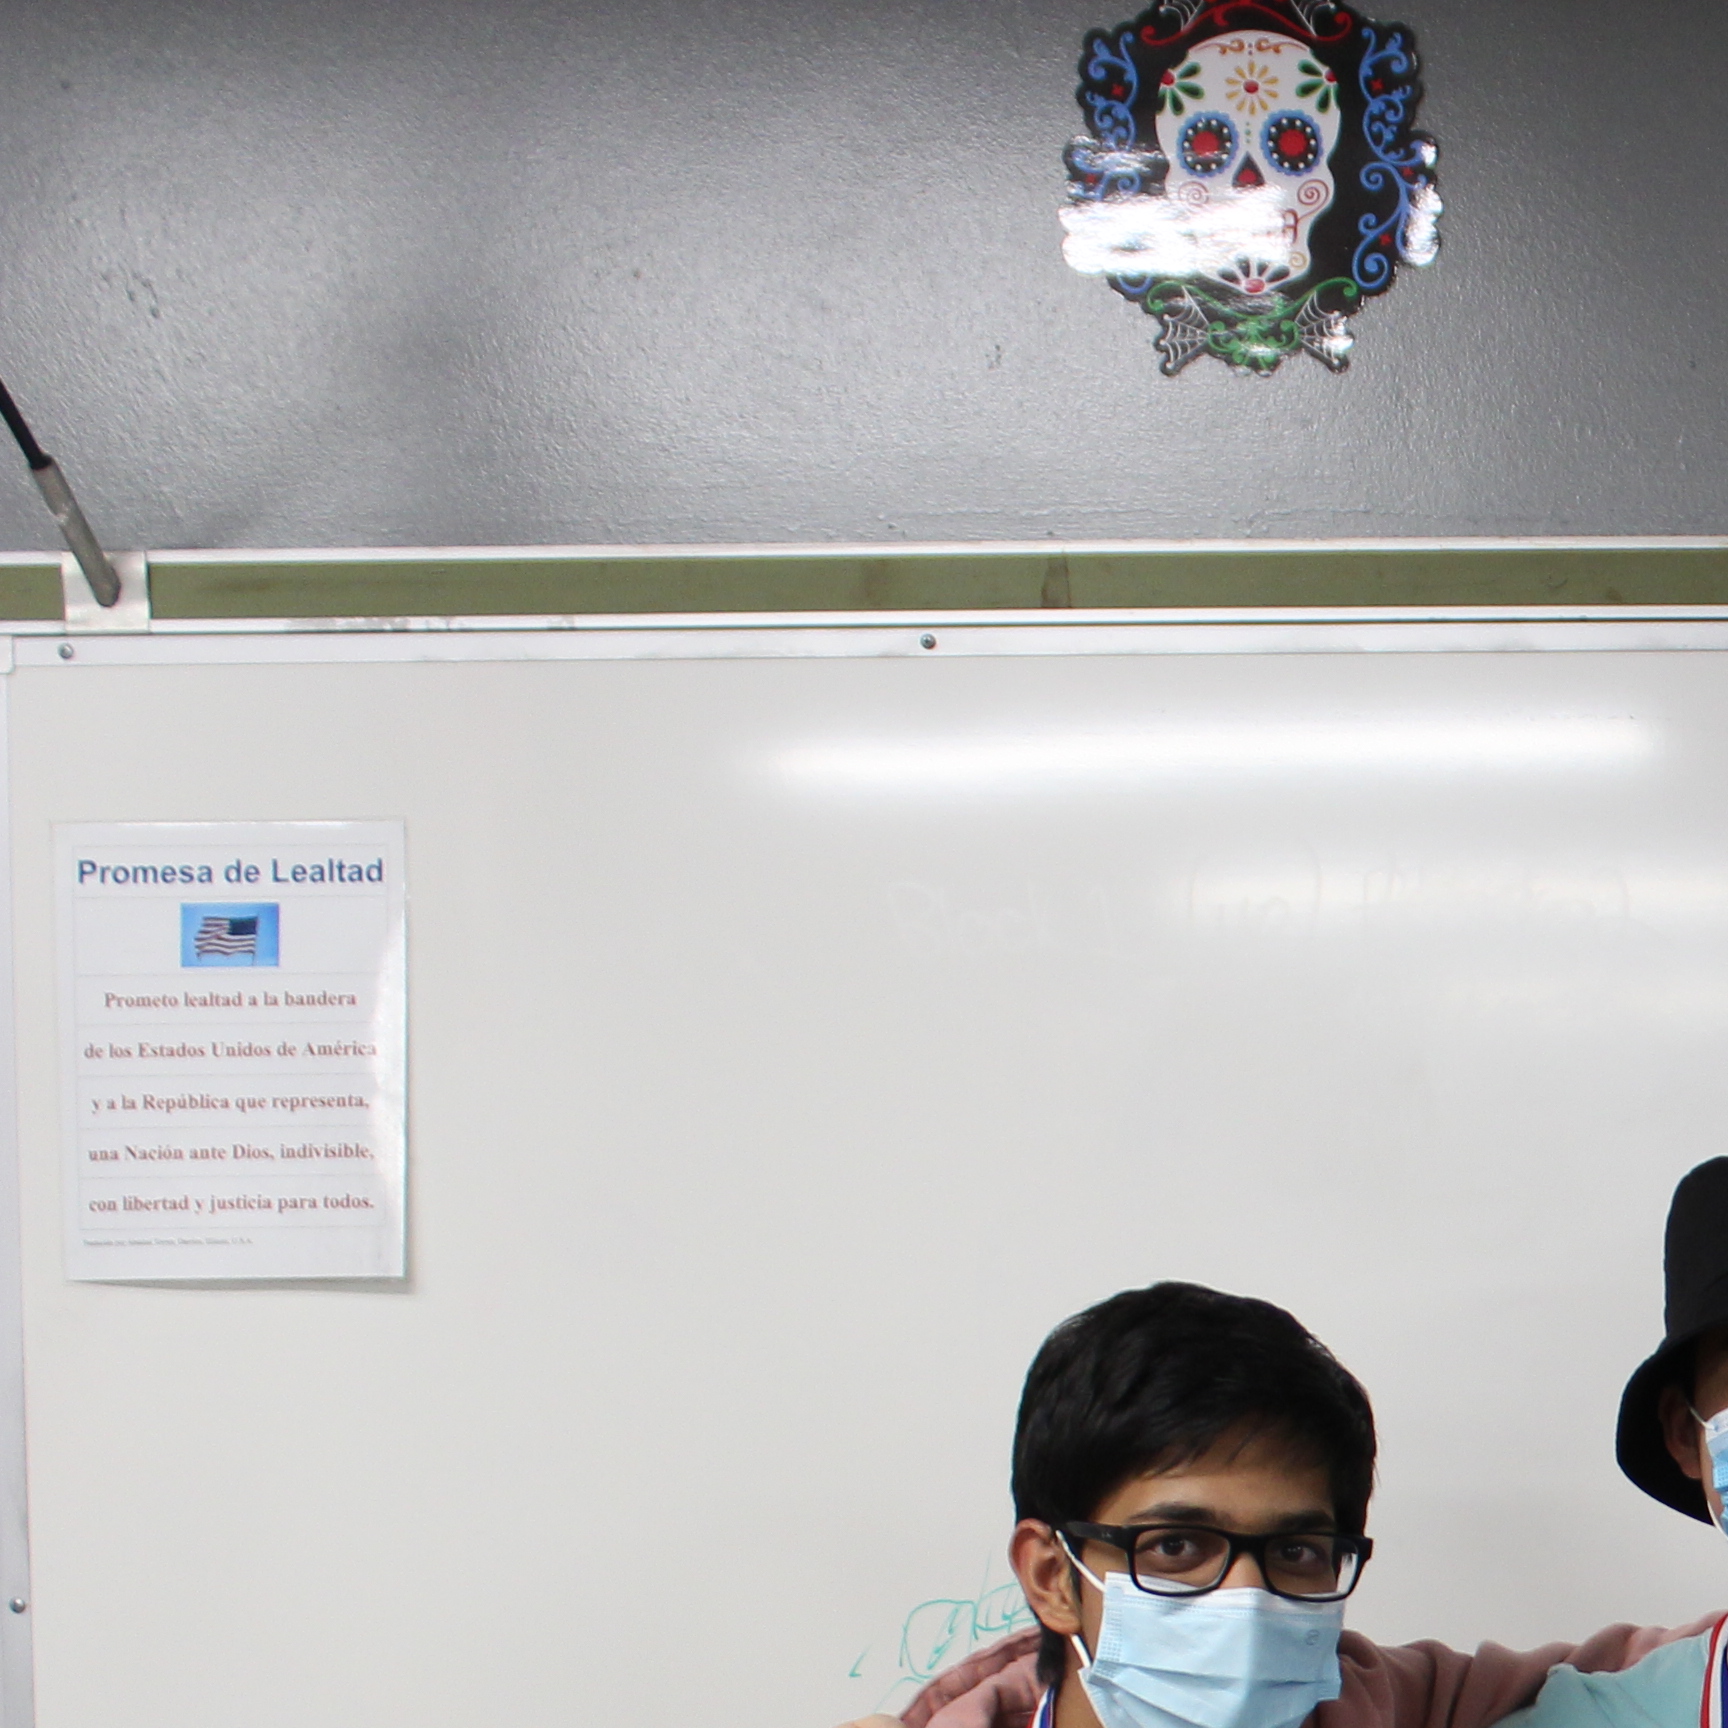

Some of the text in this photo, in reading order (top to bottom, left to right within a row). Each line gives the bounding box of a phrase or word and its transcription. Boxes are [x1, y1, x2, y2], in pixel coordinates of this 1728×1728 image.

[77, 857, 384, 884] Promesa de Lealtad
[104, 990, 358, 1008] Prometo lealtad a la bandera
[84, 1039, 378, 1059] de los Estados Unidos de América
[91, 1093, 370, 1114] y a la República que representa,
[88, 1143, 375, 1161] una Nación ante Dios, indivisible,
[89, 1194, 374, 1214] con libertad y justicia para todos.
